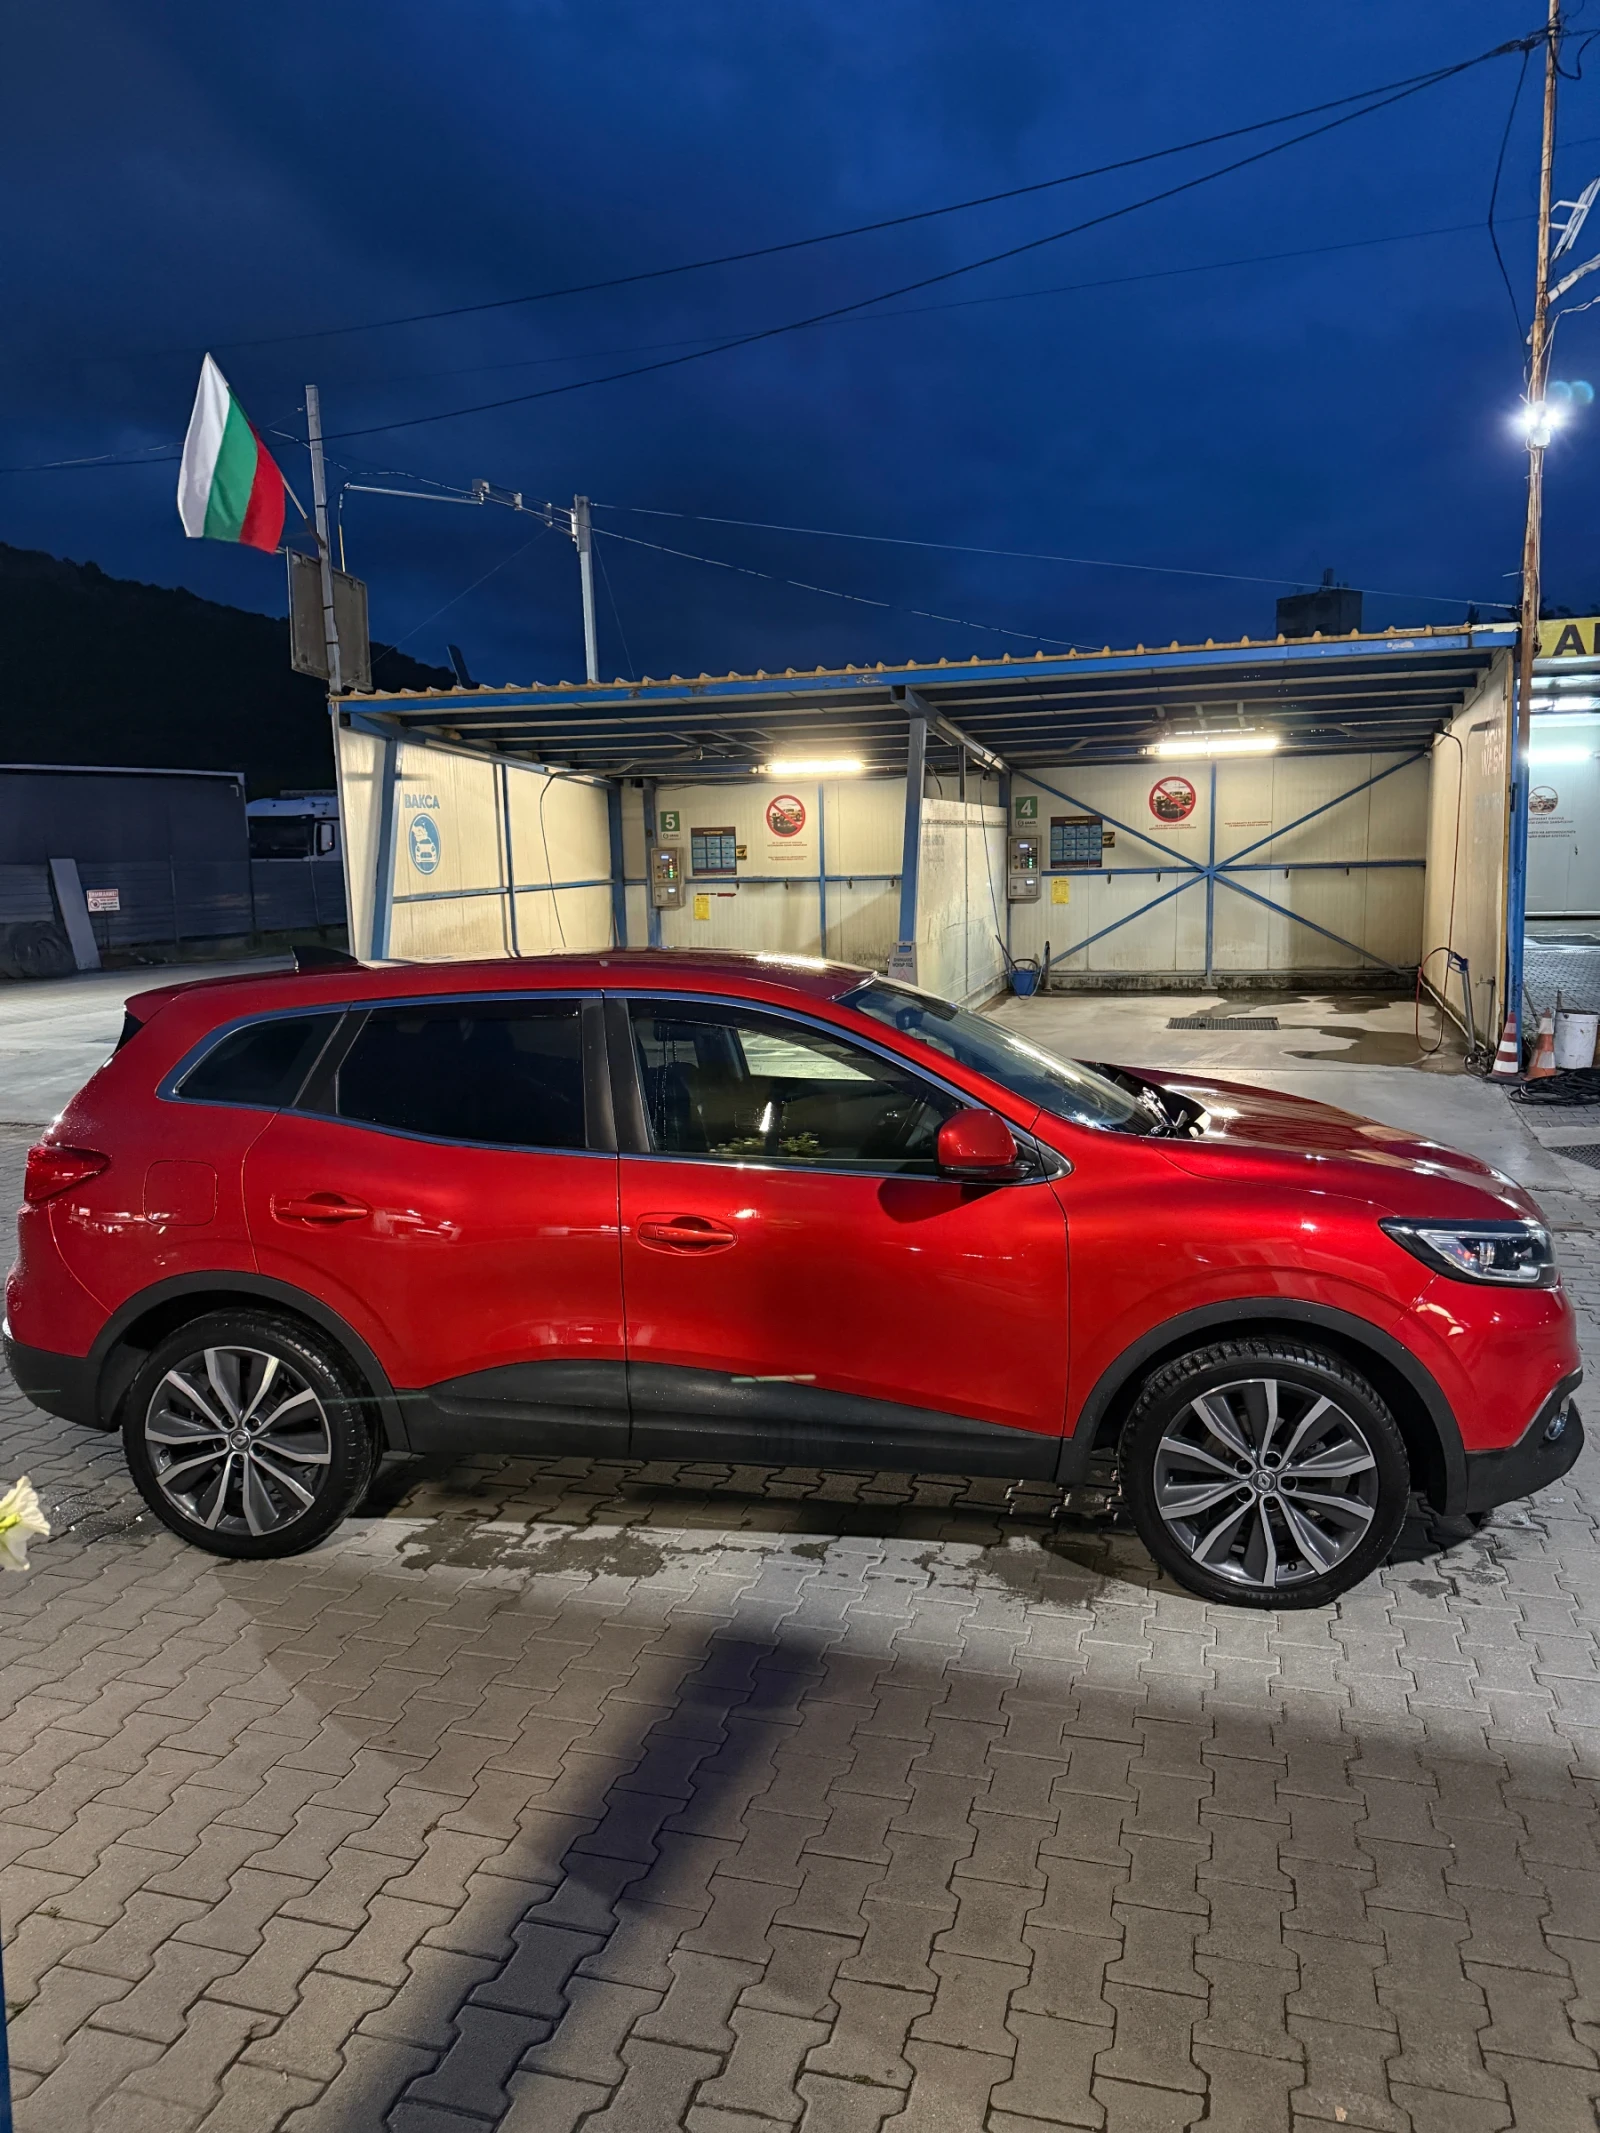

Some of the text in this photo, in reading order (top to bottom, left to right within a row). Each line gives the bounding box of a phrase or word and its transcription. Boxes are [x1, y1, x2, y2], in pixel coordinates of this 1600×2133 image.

[1552, 623, 1600, 657] А
[404, 794, 440, 809] ВАКСА
[1020, 799, 1033, 816] 4
[665, 813, 676, 830] 5
